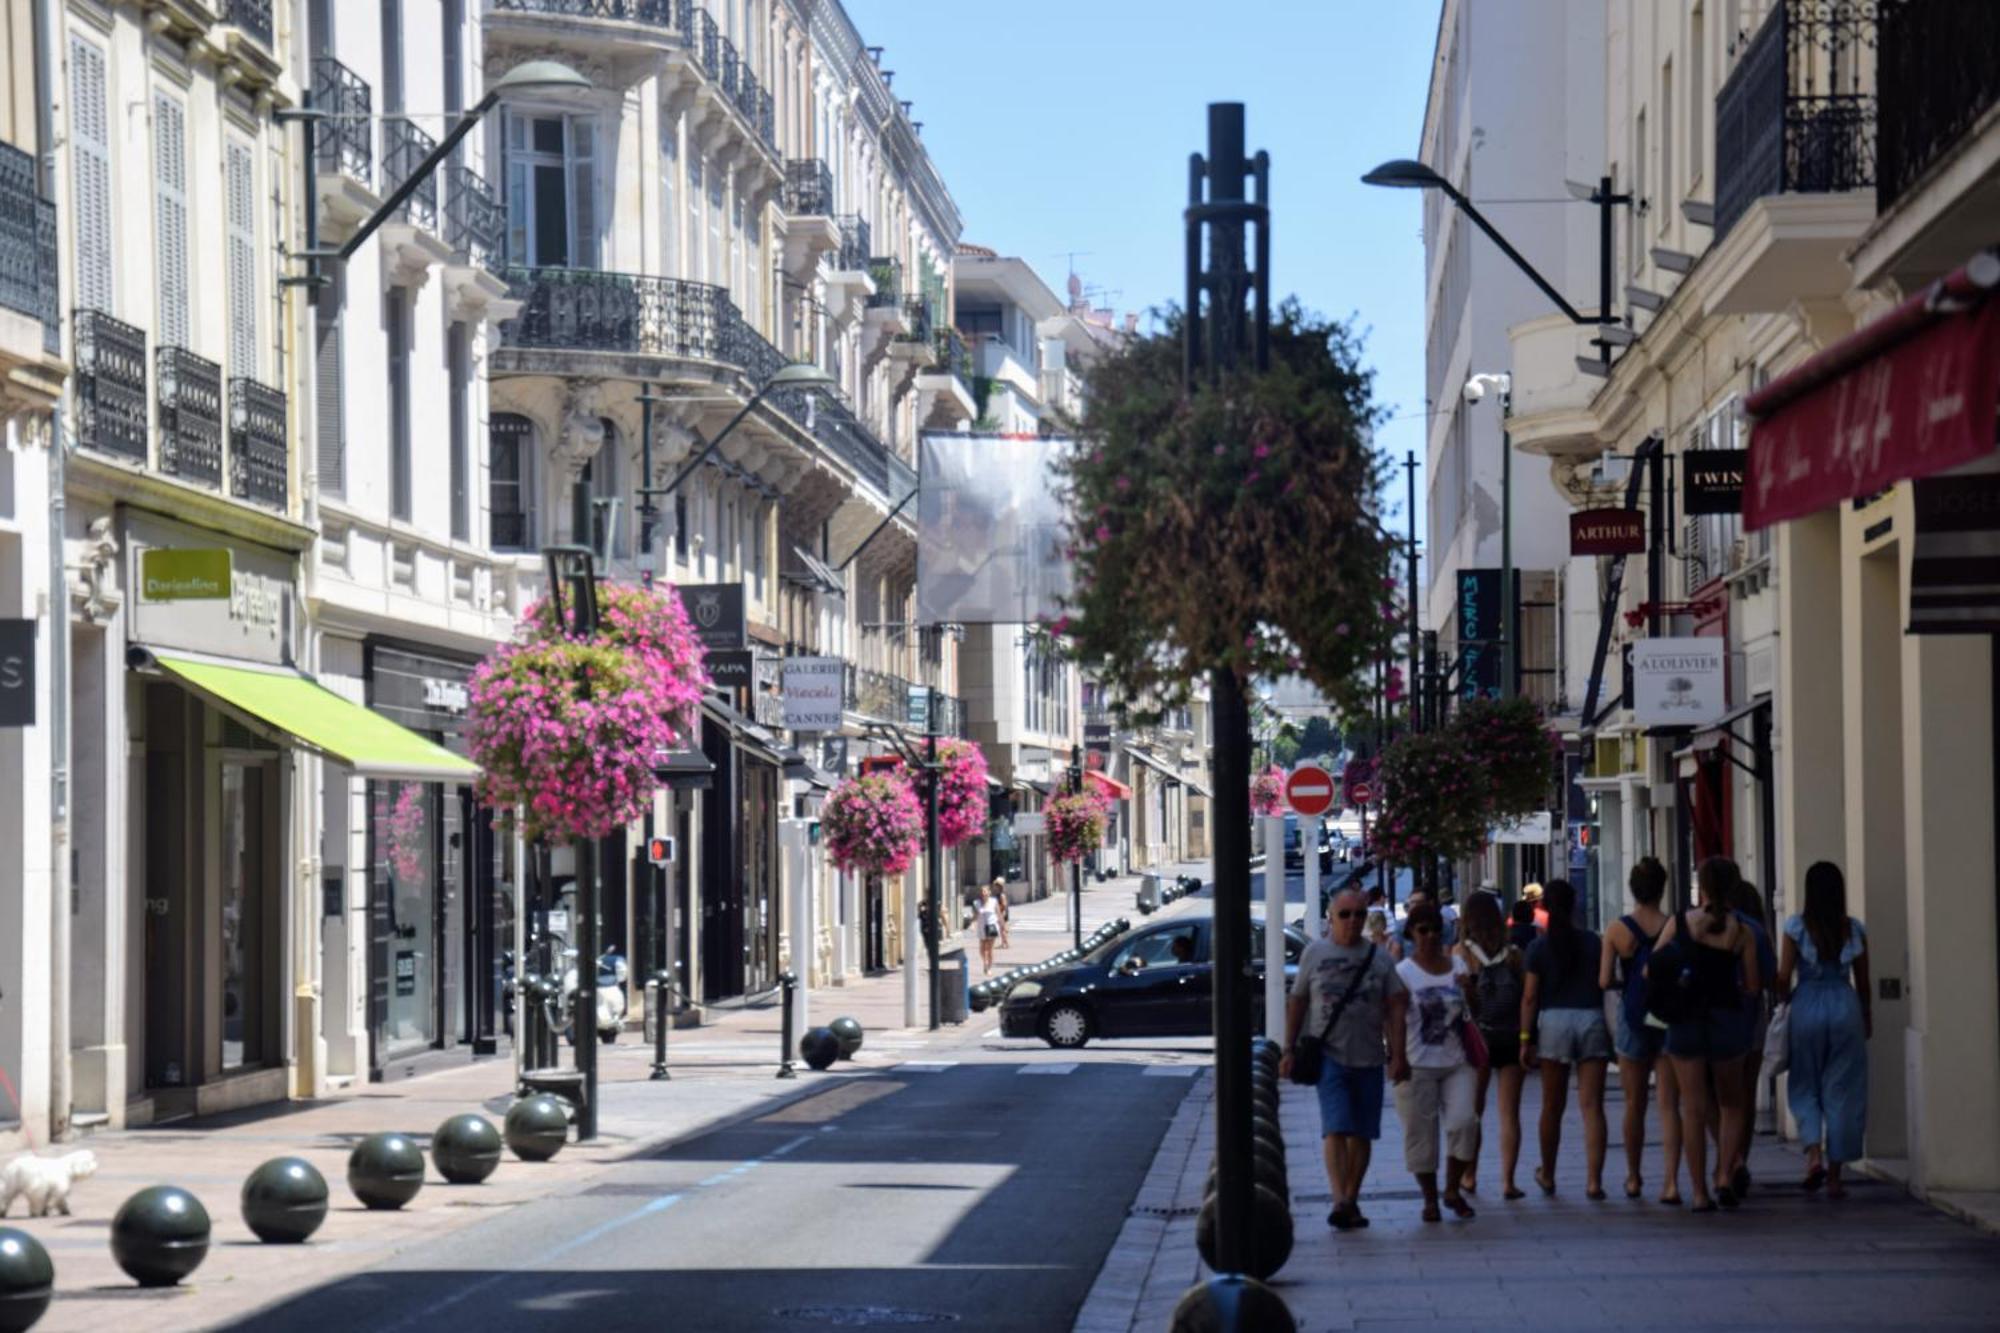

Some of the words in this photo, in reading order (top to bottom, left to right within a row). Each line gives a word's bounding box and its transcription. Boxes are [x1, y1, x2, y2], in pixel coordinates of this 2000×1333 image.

[1930, 489, 2000, 515] JOSE
[1576, 524, 1640, 541] ARTHUR
[1, 655, 22, 689] S
[784, 663, 840, 674] GALERIE
[785, 713, 840, 725] CANNES
